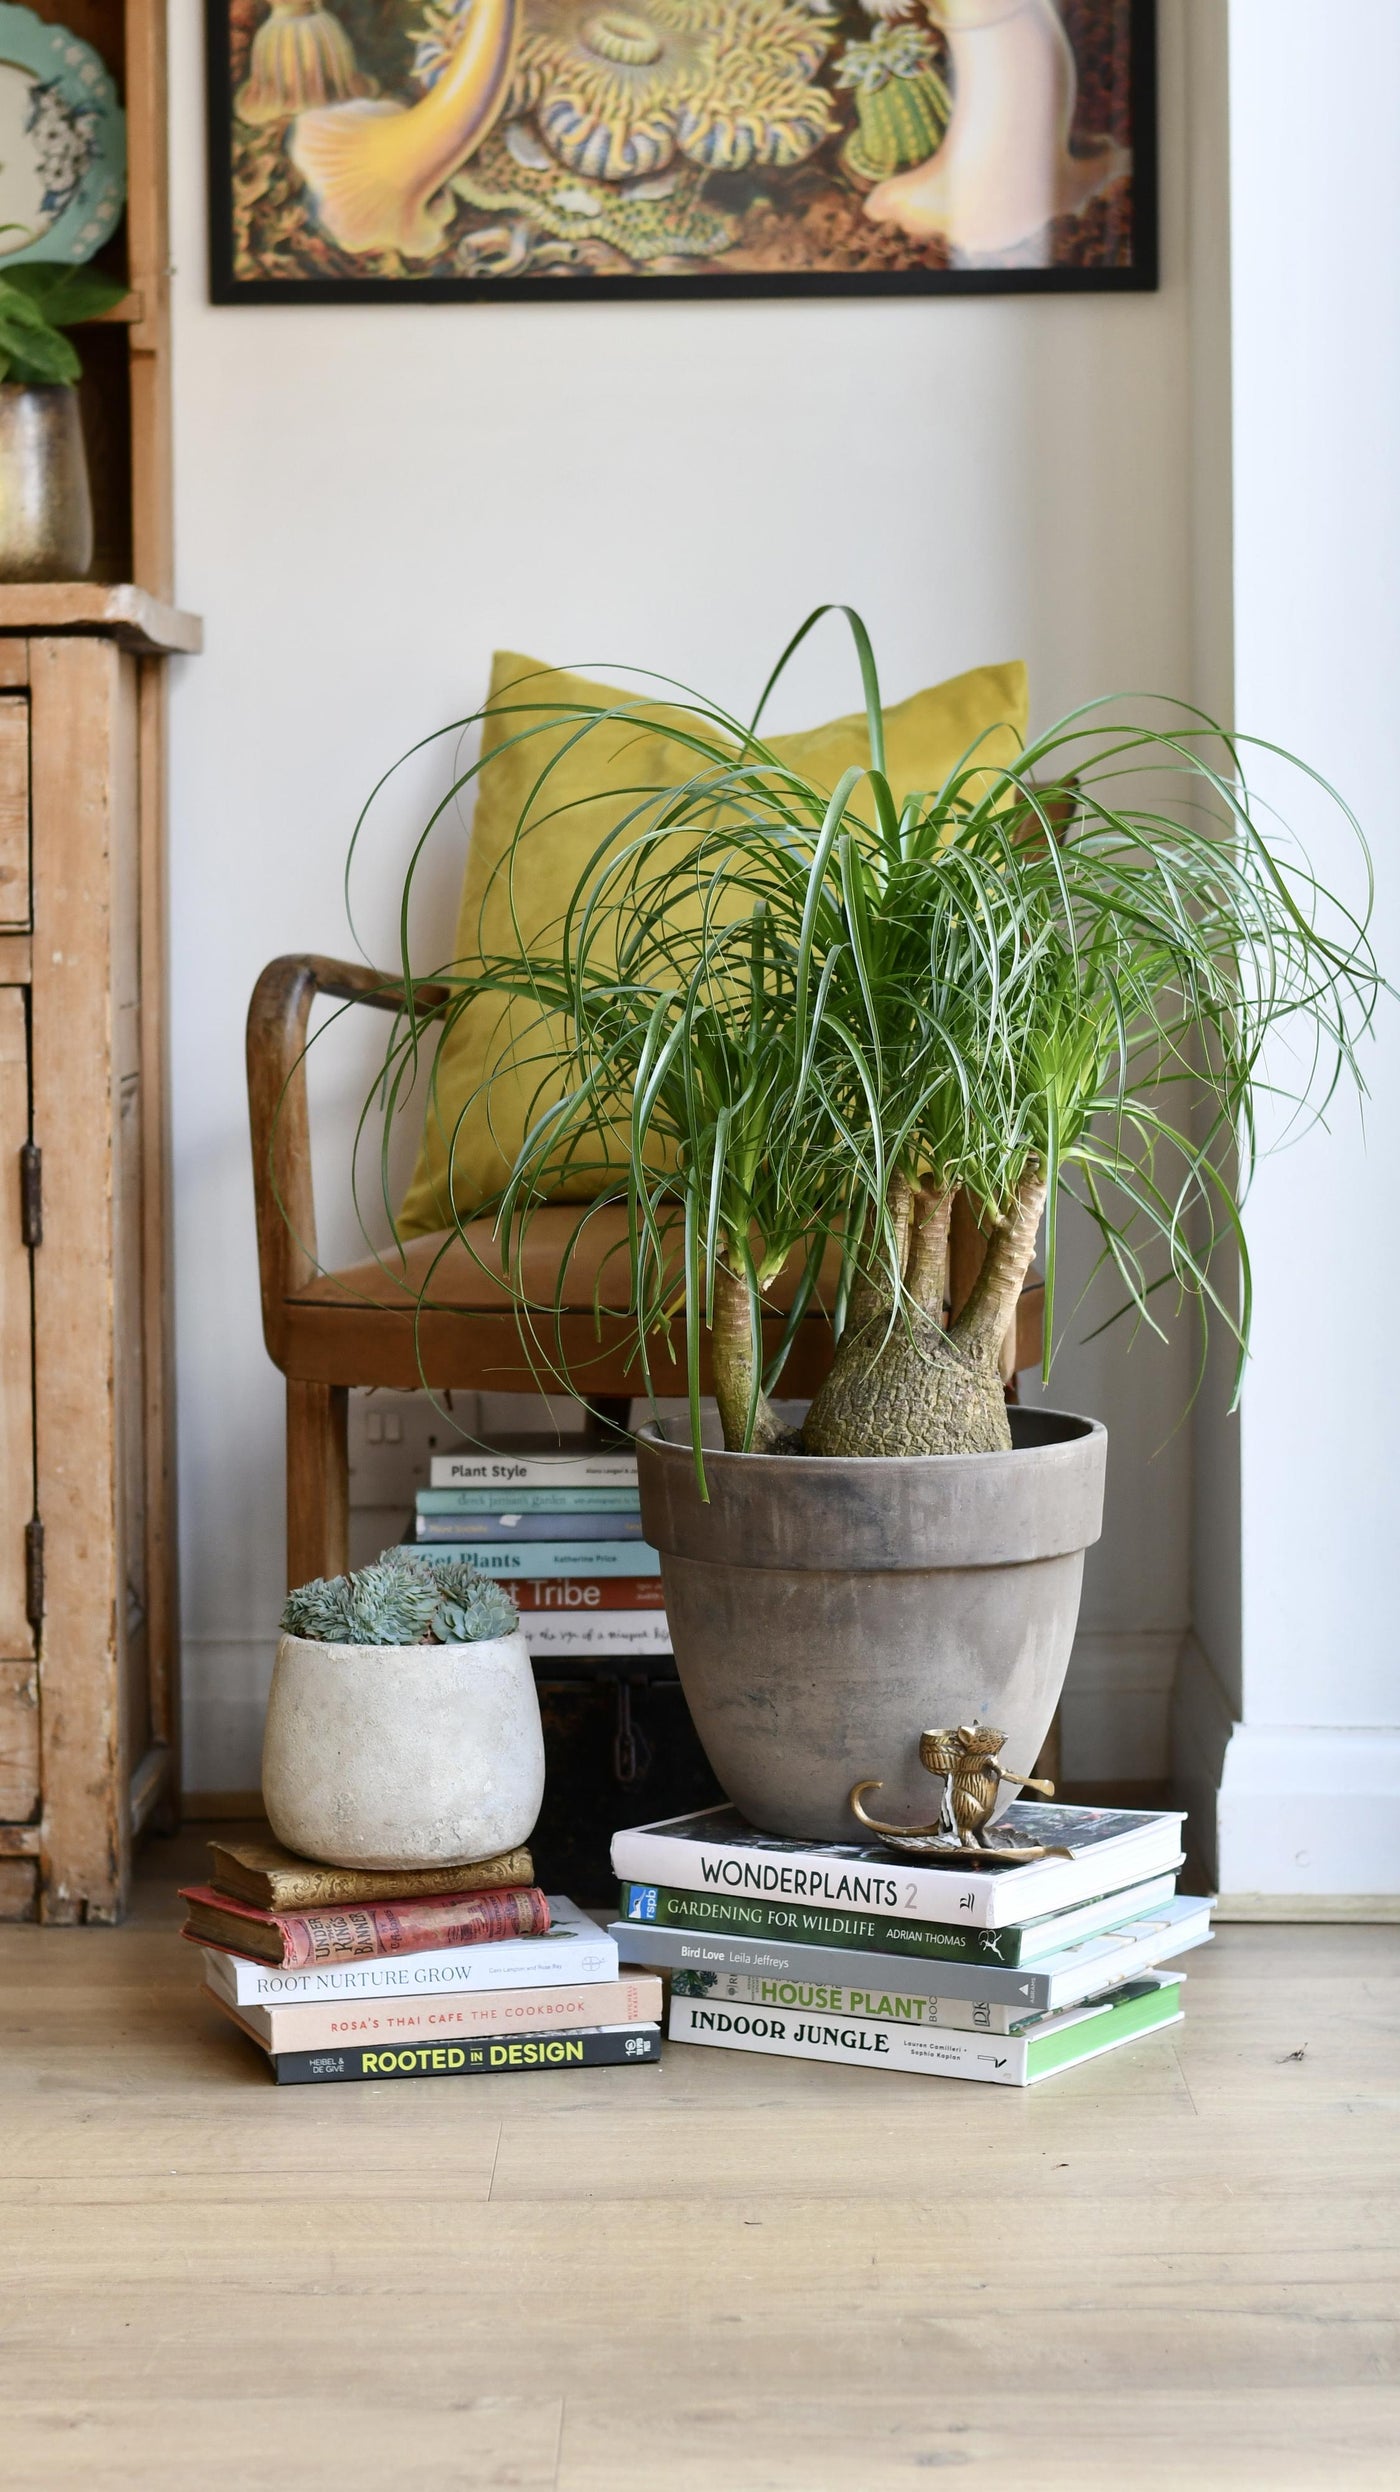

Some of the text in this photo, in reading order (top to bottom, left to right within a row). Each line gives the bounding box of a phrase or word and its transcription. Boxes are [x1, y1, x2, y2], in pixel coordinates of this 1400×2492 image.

[451, 1465, 527, 1480] Plant Style
[460, 1552, 521, 1568] Plants
[554, 1554, 617, 1563] Katherine Price
[526, 1578, 601, 1606] Tribe
[701, 1856, 918, 1910] WONDERPLANTS 2
[645, 1889, 658, 1920] rspb
[326, 1922, 335, 1939] THE
[330, 1915, 354, 1952] KING'S
[349, 1911, 374, 1955] BANNER
[667, 1898, 966, 1948] GARDENING FOR WILDLIFE ADRIAN THOMAS
[308, 1916, 331, 1960] UNDER
[681, 1945, 789, 1970] Bird Love Leila Jeffreys
[257, 1965, 472, 1993] ROOT NURTURE GROW
[1029, 1977, 1037, 2004] ABRAMS
[761, 1980, 843, 2011] HOUSE
[850, 1990, 927, 2021] PLANT
[928, 1995, 938, 2022] BOO
[331, 2001, 586, 2032] ROSA'S THAI CAFE THE COOKBOOK
[691, 2010, 890, 2053] INDOOR JUNGLE
[362, 2040, 585, 2074] ROOTED IN DESIGN
[903, 2039, 928, 2049] Lauren
[929, 2043, 962, 2053] Camilleri
[910, 2048, 961, 2061] Sophia Kaplan
[309, 2057, 345, 2067] HEIBEL &
[312, 2064, 345, 2074] DE GIVE
